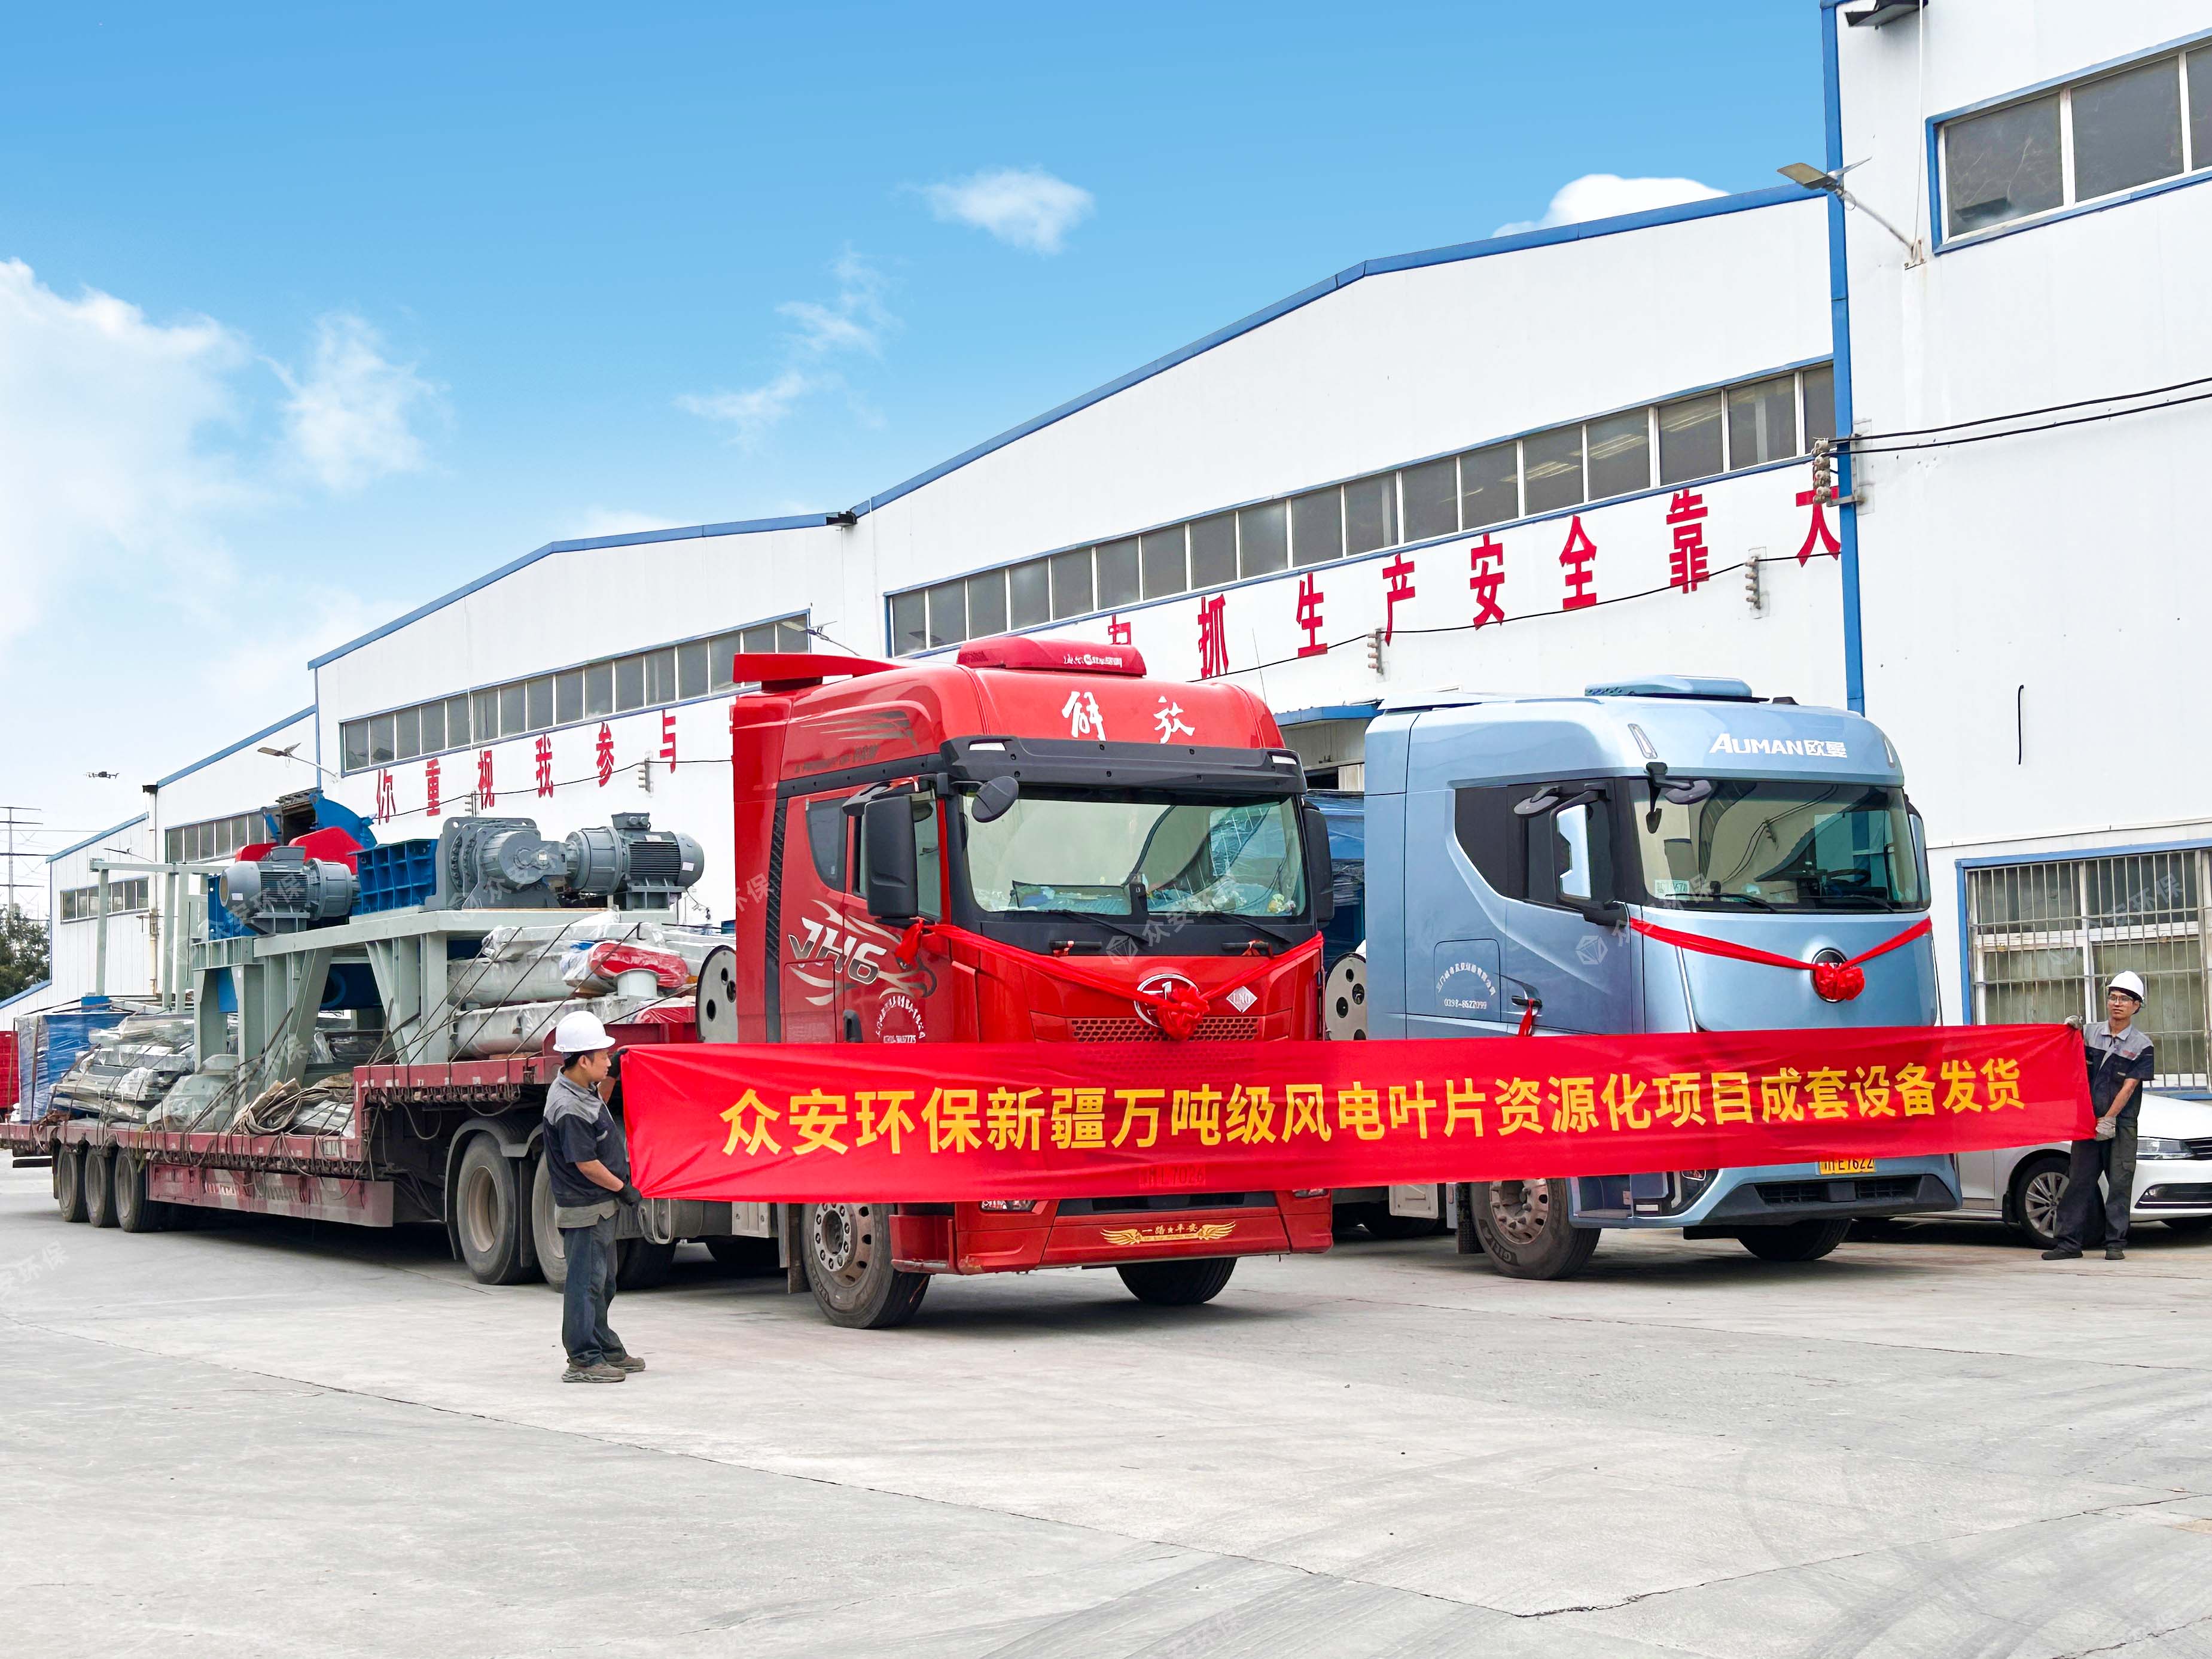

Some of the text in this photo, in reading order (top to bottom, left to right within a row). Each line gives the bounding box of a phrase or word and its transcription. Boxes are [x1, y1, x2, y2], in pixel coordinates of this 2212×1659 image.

[1061, 690, 1196, 743] 解放
[377, 709, 735, 825] 你重视我参与
[788, 917, 888, 985] JH6
[720, 1058, 2025, 1156] 众安环保新疆万吨级风电叶片资源化项目成套设备发货
